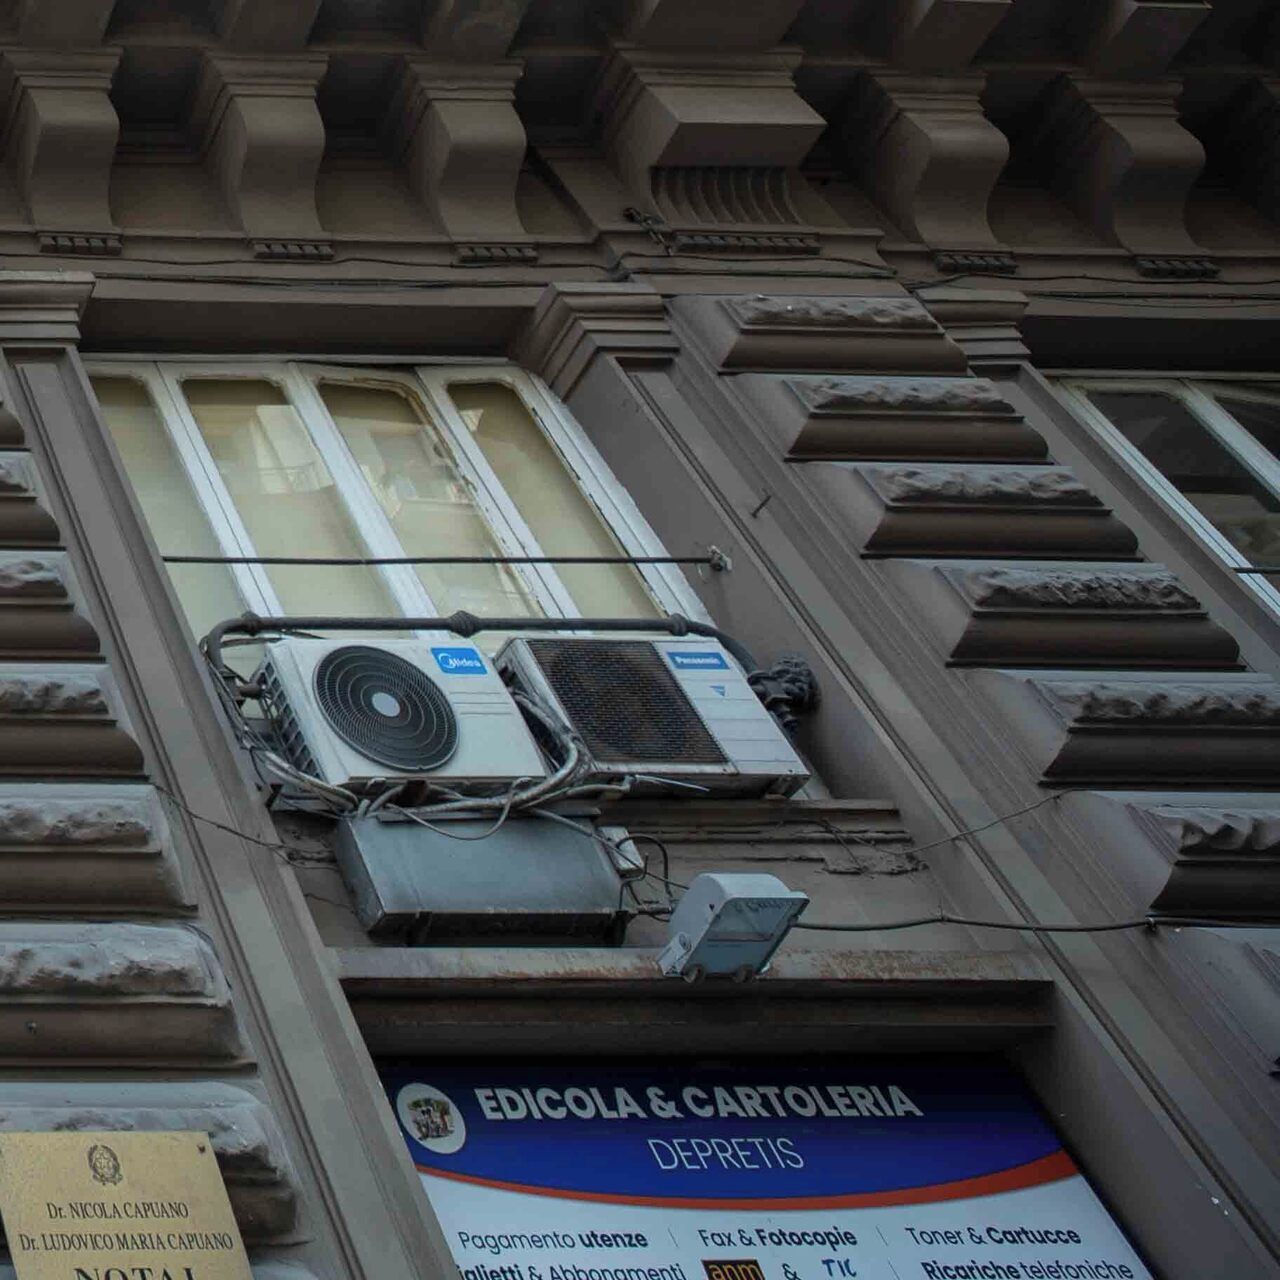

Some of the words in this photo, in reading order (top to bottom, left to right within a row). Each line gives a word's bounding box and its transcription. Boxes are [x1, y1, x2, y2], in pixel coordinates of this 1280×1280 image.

[473, 1086, 648, 1120] EDICOLA
[646, 1085, 685, 1119] &
[682, 1084, 925, 1118] CARTOLERIA
[647, 1137, 805, 1170] DEPRETIS
[46, 1202, 67, 1219] Dr.
[69, 1201, 122, 1219] NICOLA
[123, 1201, 189, 1219] CAPUANO
[19, 1233, 40, 1251] Dr.
[41, 1232, 114, 1251] LUDOVICO
[116, 1232, 166, 1251] MARIA
[166, 1231, 234, 1251] CAPUANO
[457, 1231, 576, 1255] Pagamento
[577, 1231, 648, 1248] utenze
[697, 1228, 734, 1247] Fax
[737, 1228, 757, 1247] &
[754, 1226, 858, 1251] Fotocopie
[904, 1226, 963, 1246] Toner
[966, 1226, 988, 1245] &
[986, 1226, 1082, 1245] Cartucce
[920, 1260, 1020, 1280] Ricariche
[1019, 1260, 1134, 1280] telefoniche
